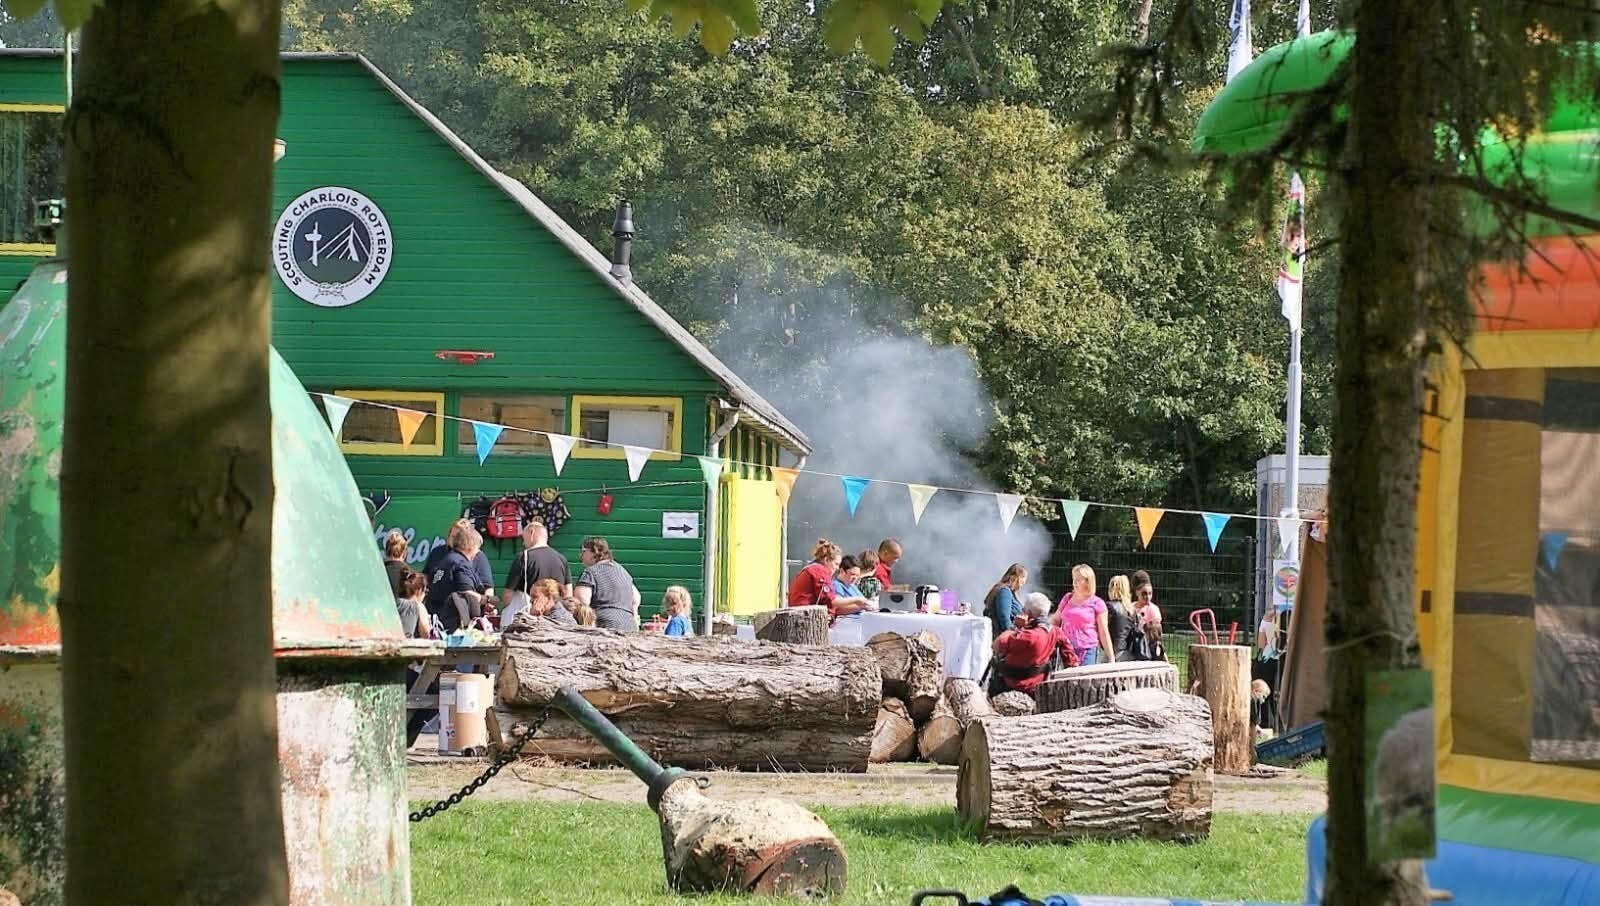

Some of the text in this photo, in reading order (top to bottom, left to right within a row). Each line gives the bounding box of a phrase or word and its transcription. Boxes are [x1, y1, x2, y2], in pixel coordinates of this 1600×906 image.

[278, 192, 387, 286] SCOUTING CHARLOIS ROTTERDAM
